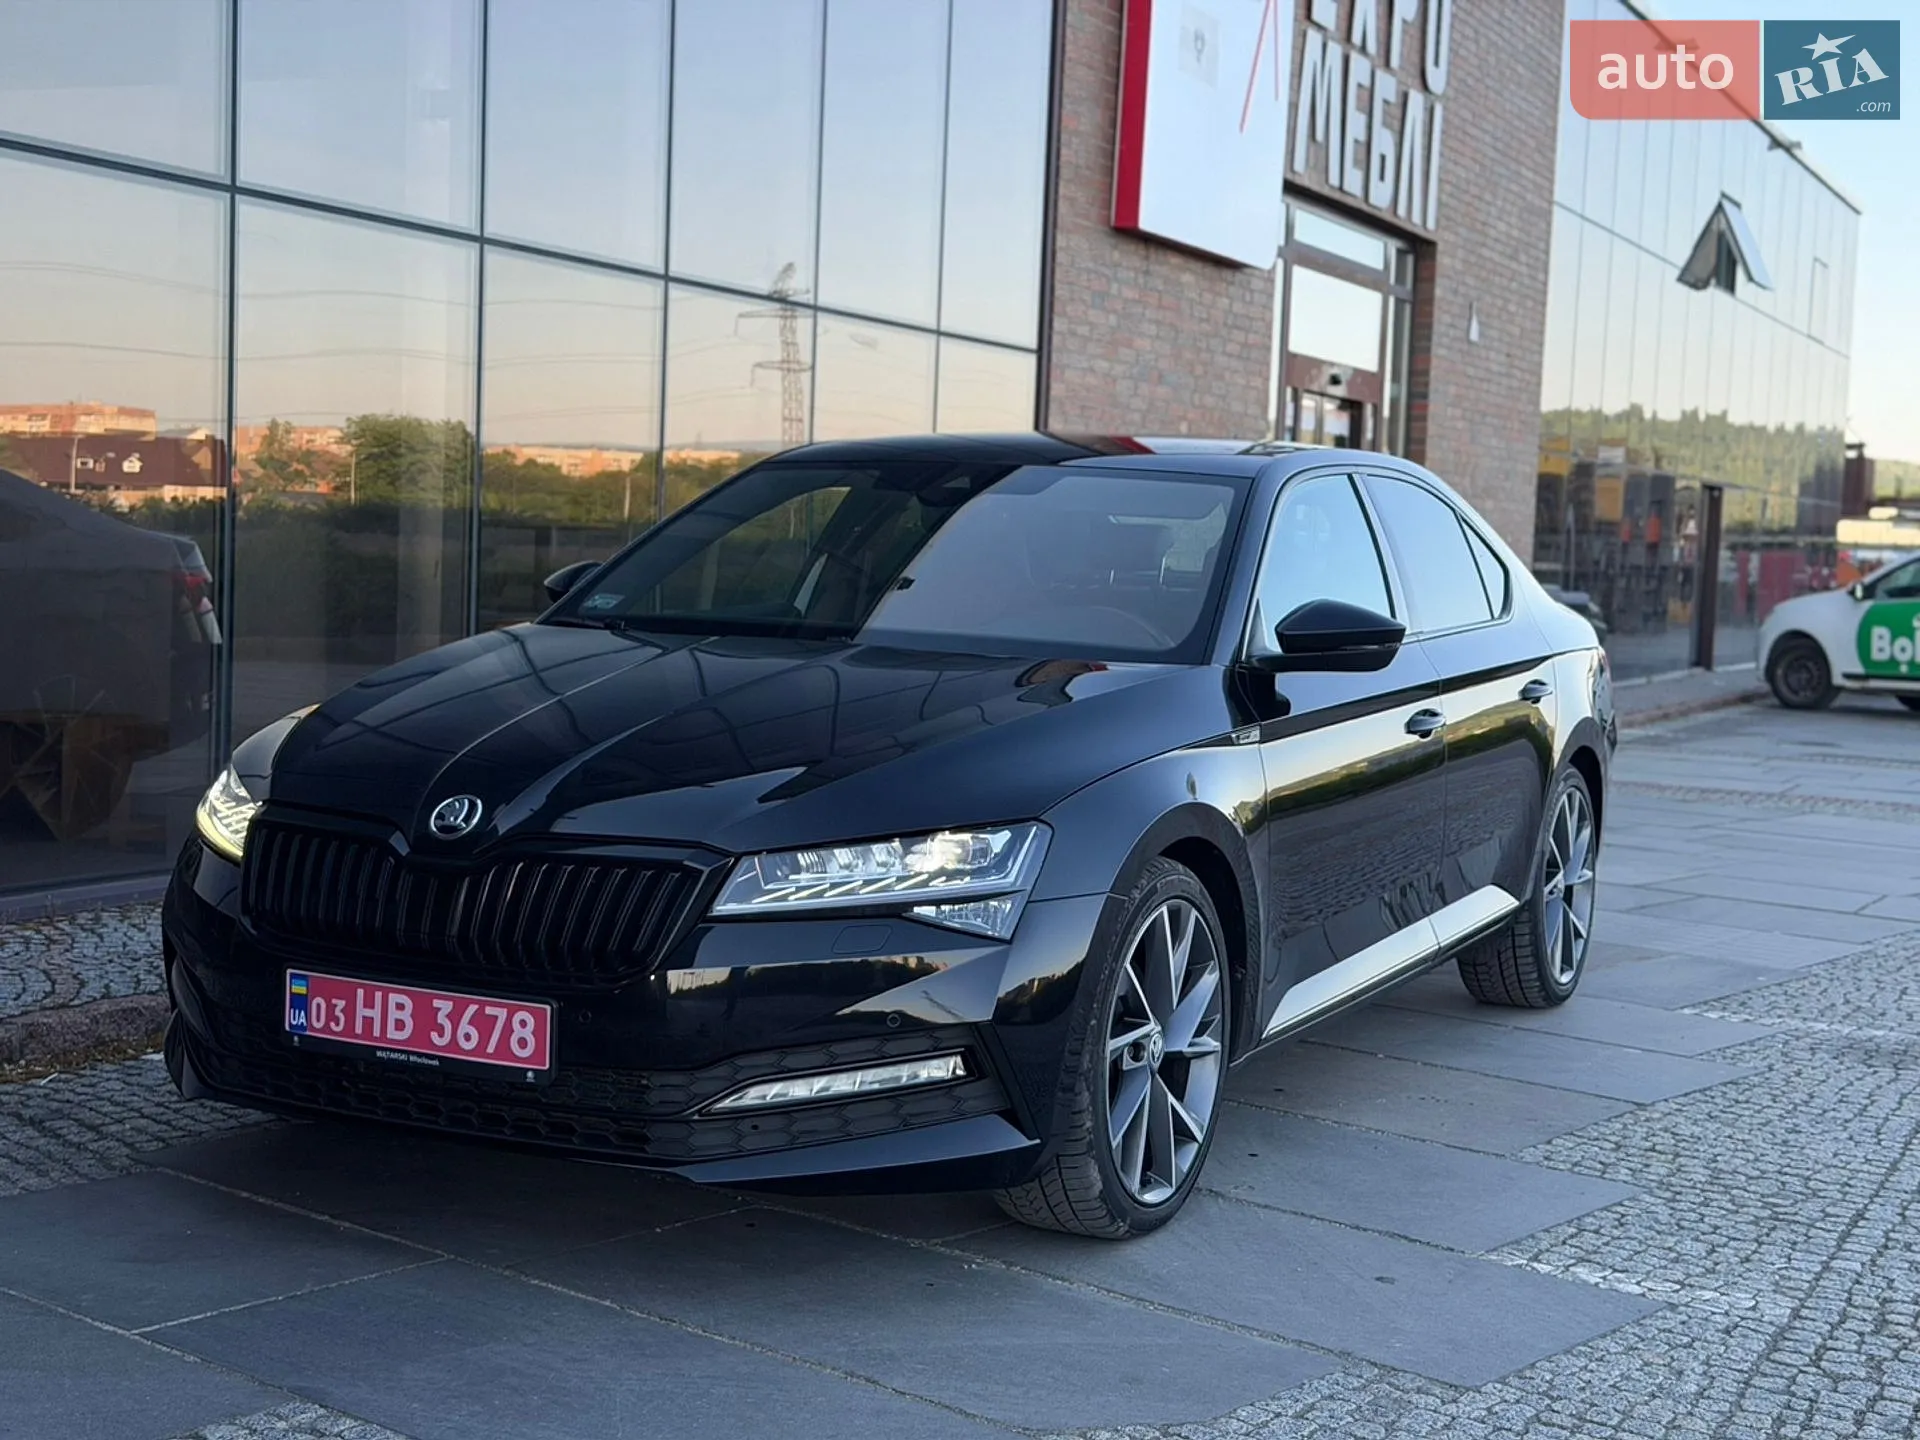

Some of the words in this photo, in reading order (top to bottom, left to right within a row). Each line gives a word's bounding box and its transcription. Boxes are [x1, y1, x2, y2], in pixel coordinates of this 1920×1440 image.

[1293, 27, 1443, 231] МЕБЛІ
[290, 1009, 307, 1027] UA
[310, 996, 346, 1032] 03
[354, 988, 414, 1040] HB
[430, 999, 536, 1058] 3678
